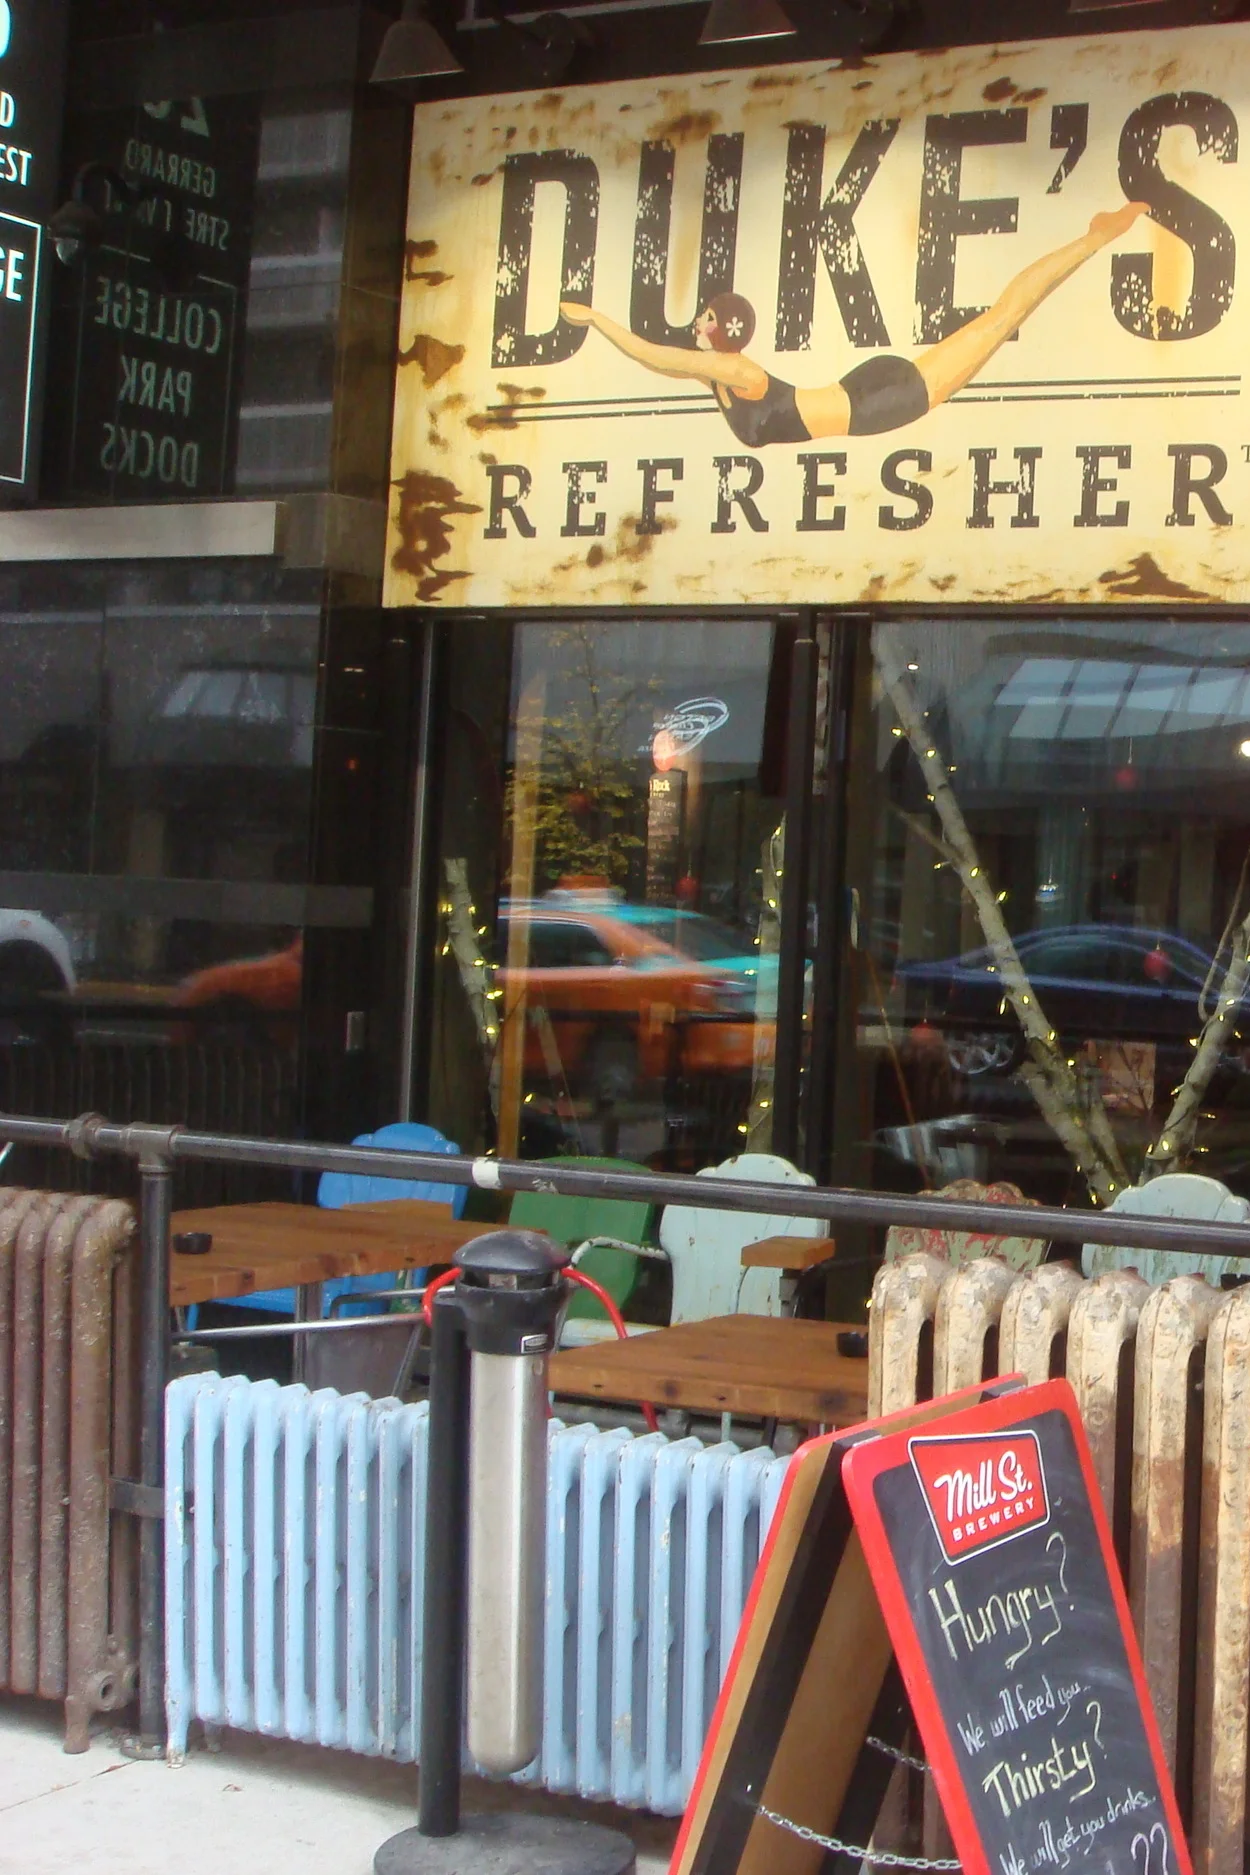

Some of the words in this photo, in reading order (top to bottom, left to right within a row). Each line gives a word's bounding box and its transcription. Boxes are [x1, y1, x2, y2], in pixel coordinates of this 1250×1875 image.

[490, 92, 1238, 369] DUKE'S
[483, 442, 1233, 540] REFRESHER
[934, 1459, 996, 1522] Mill
[998, 1450, 1033, 1501] St.
[952, 1497, 1034, 1542] BREWERY
[929, 1531, 1075, 1670] Hungry?
[957, 1713, 986, 1756] We
[990, 1688, 1018, 1737] will
[1016, 1674, 1055, 1724] feed
[982, 1701, 1108, 1818] Thirsty?
[1056, 1816, 1080, 1869] get
[1080, 1817, 1106, 1855] you
